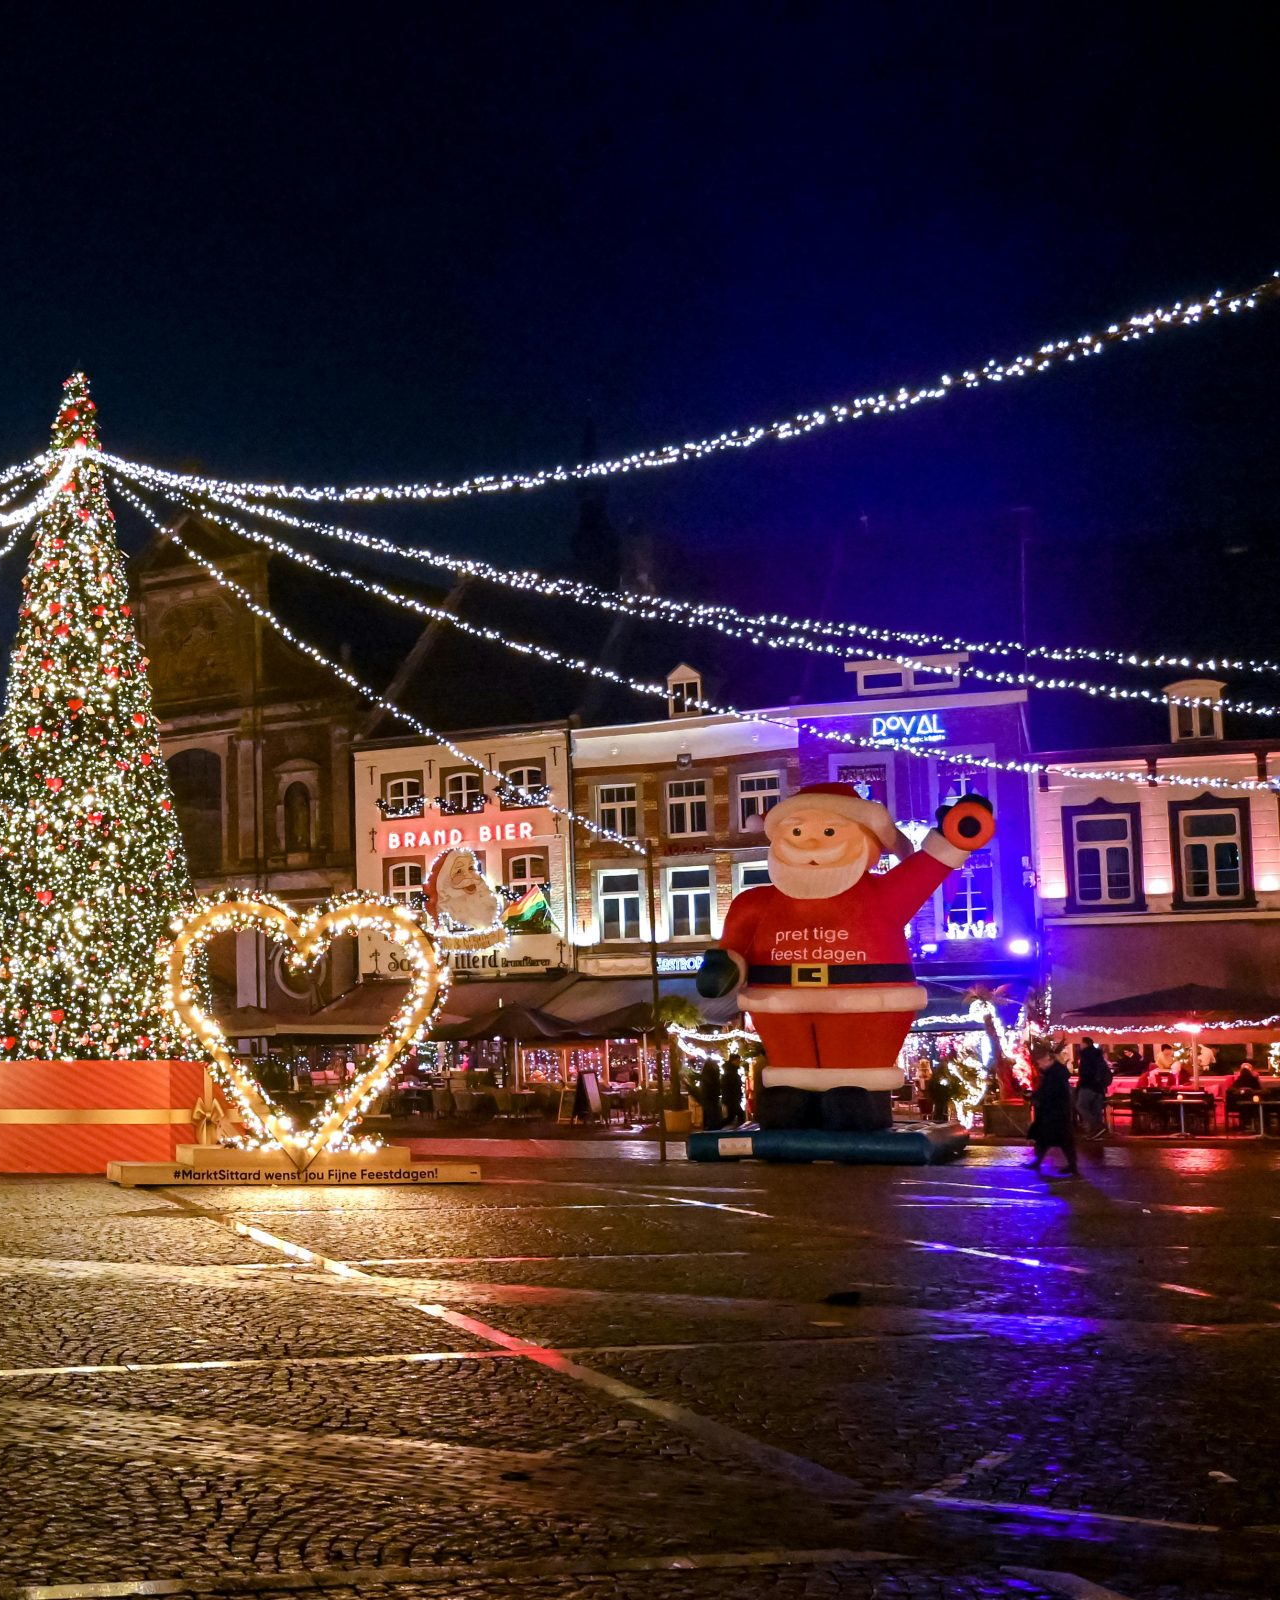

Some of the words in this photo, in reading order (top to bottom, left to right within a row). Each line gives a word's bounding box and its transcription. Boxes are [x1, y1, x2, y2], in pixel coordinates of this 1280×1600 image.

[388, 829, 463, 849] BRAND
[479, 822, 533, 842] BIER
[775, 928, 809, 944] pret
[813, 927, 849, 943] tige
[771, 947, 808, 960] feest
[812, 946, 866, 963] dagen
[173, 1169, 261, 1180] #MarktSittard
[264, 1170, 301, 1180] wenst
[304, 1169, 324, 1182] jou
[328, 1169, 357, 1182] Fijne
[360, 1168, 438, 1181] Feestdagen!
